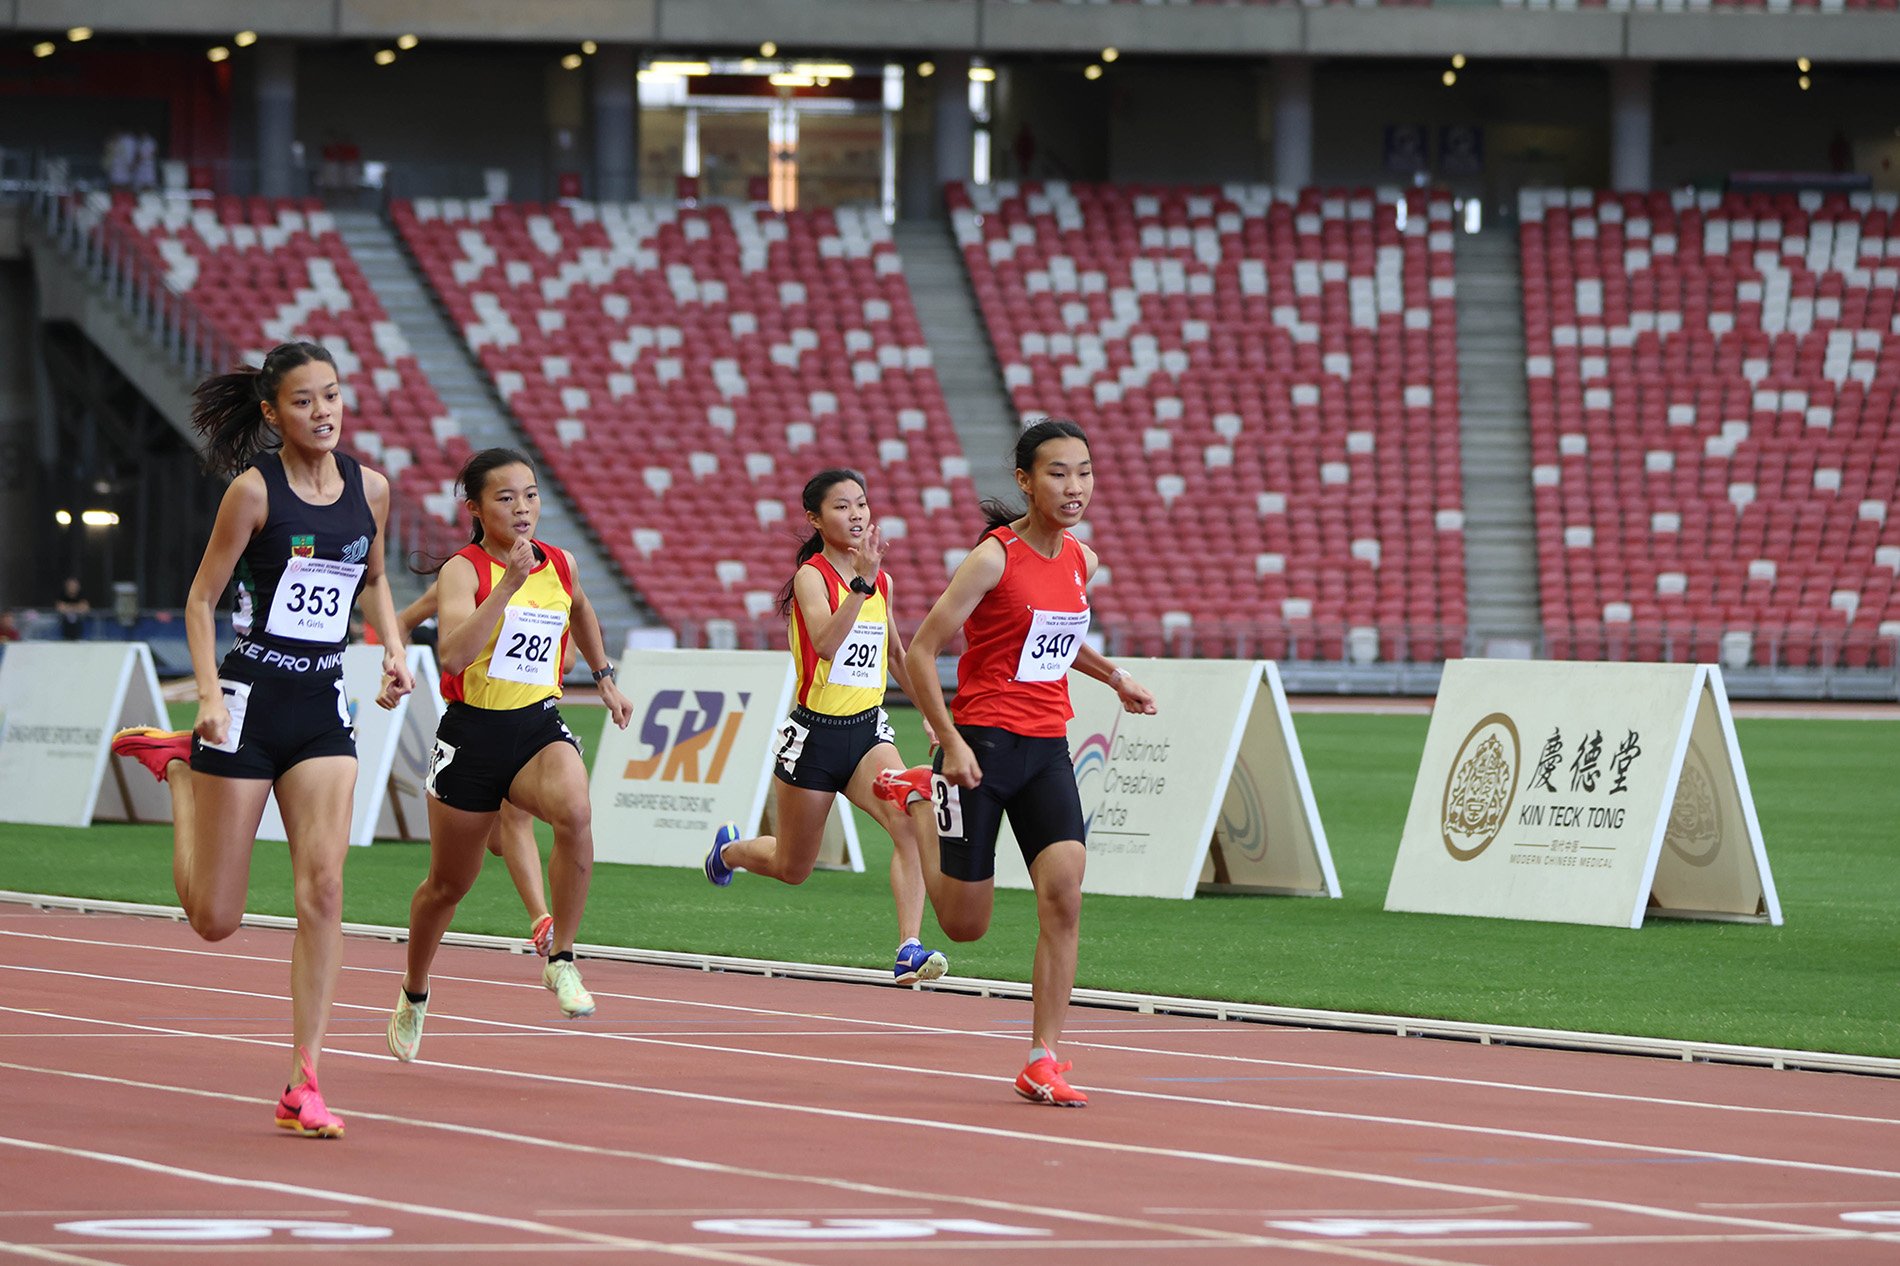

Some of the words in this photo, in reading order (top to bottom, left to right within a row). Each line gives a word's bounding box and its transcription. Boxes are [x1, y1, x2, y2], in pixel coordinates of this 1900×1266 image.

[286, 583, 340, 617] 353
[306, 619, 324, 628] Girls
[505, 632, 552, 662] 282
[843, 643, 877, 668] 292
[1031, 633, 1075, 659] 340
[262, 650, 310, 672] PRO
[525, 664, 538, 674] Girls
[856, 670, 869, 678] Girls
[1047, 662, 1060, 671] Girls
[623, 690, 752, 784] SRI
[1111, 735, 1170, 762] Distinct
[1526, 726, 1642, 795] 慶德堂
[1104, 767, 1165, 795] Creative
[937, 780, 952, 832] 3
[1093, 800, 1128, 827] Arts
[1519, 804, 1545, 826] KIN
[1548, 805, 1585, 828] TECK
[1586, 807, 1626, 829] TONG
[1509, 854, 1542, 864] MODERN
[1544, 855, 1577, 867] CHINESE
[1580, 857, 1612, 868] MEDICAL
